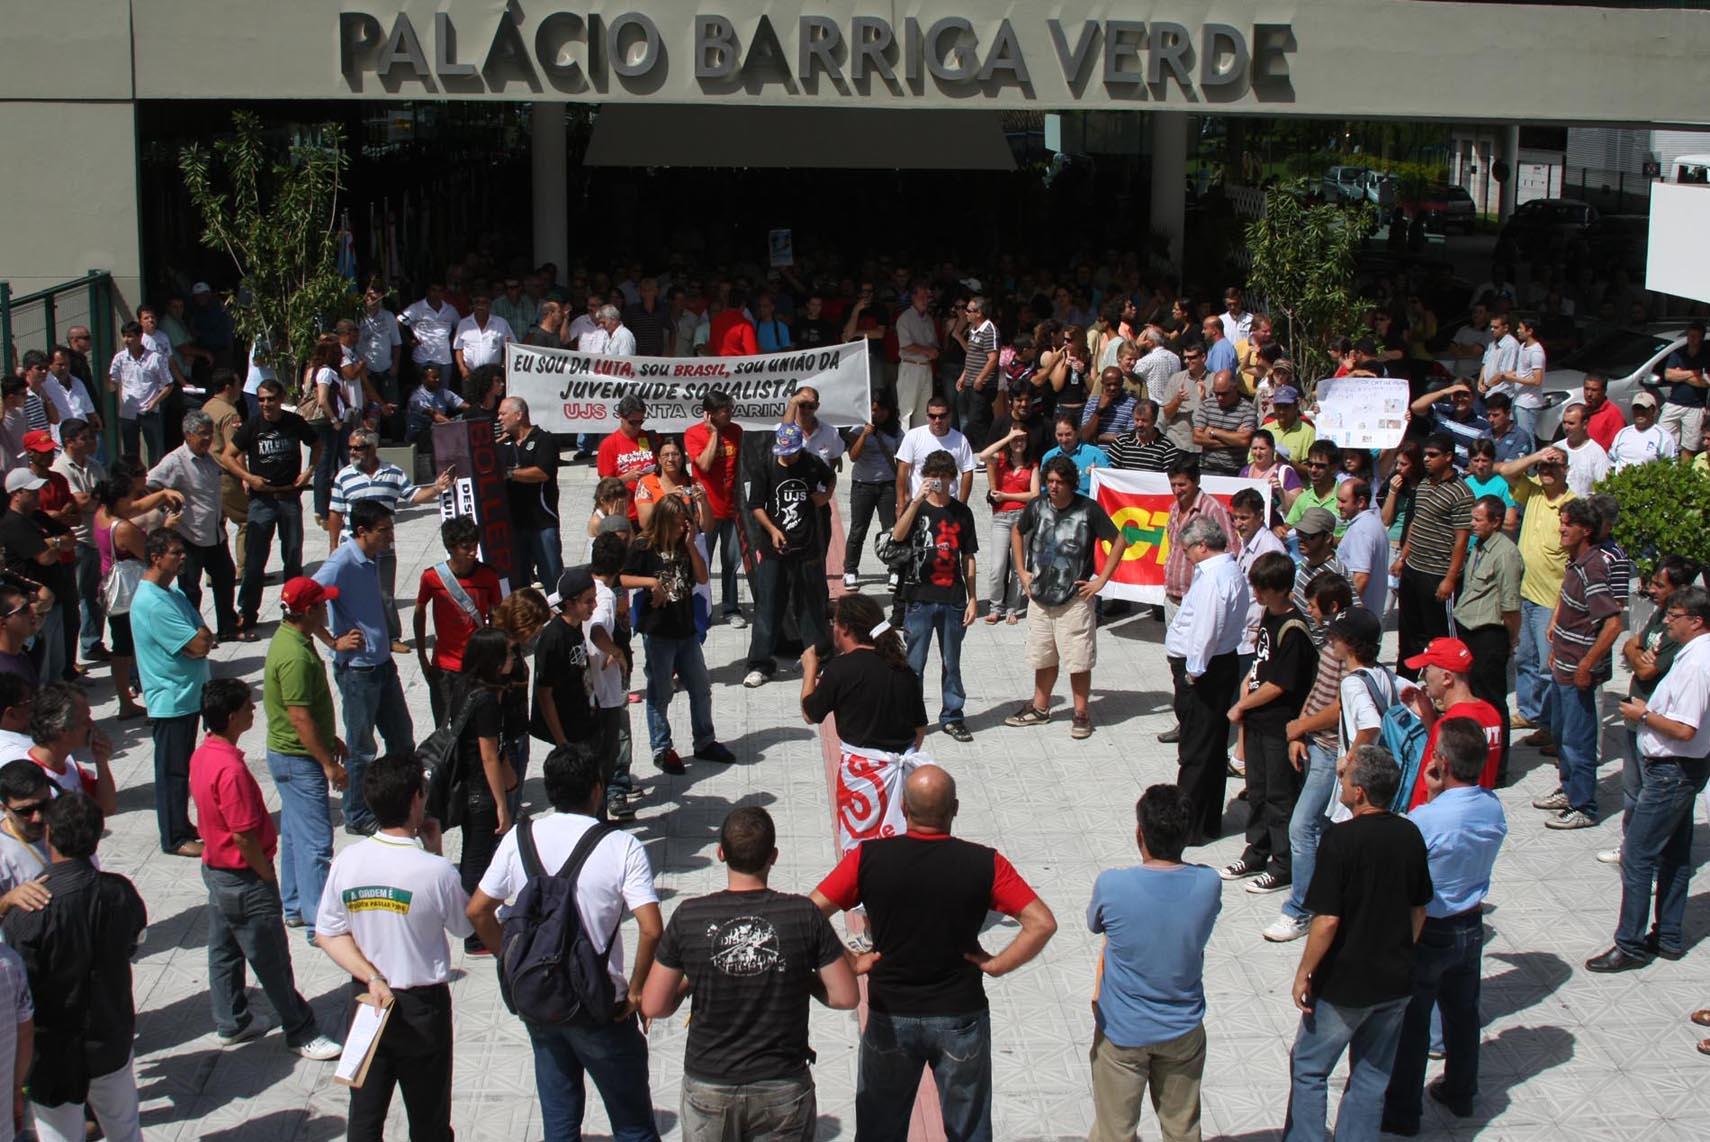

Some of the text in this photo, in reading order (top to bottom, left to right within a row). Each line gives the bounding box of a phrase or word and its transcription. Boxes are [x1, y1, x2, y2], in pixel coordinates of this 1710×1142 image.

[338, 0, 1297, 102] PALÁCIO BARRIGA VERDE
[513, 350, 841, 379] EU SOU DA LUTA, SOU BRASIL, SOU UNIÃO DA
[559, 380, 680, 401] JUVENTUDE
[563, 402, 786, 419] UJS SNTA CARIN
[783, 491, 807, 502] UJS
[1101, 506, 1170, 566] CT
